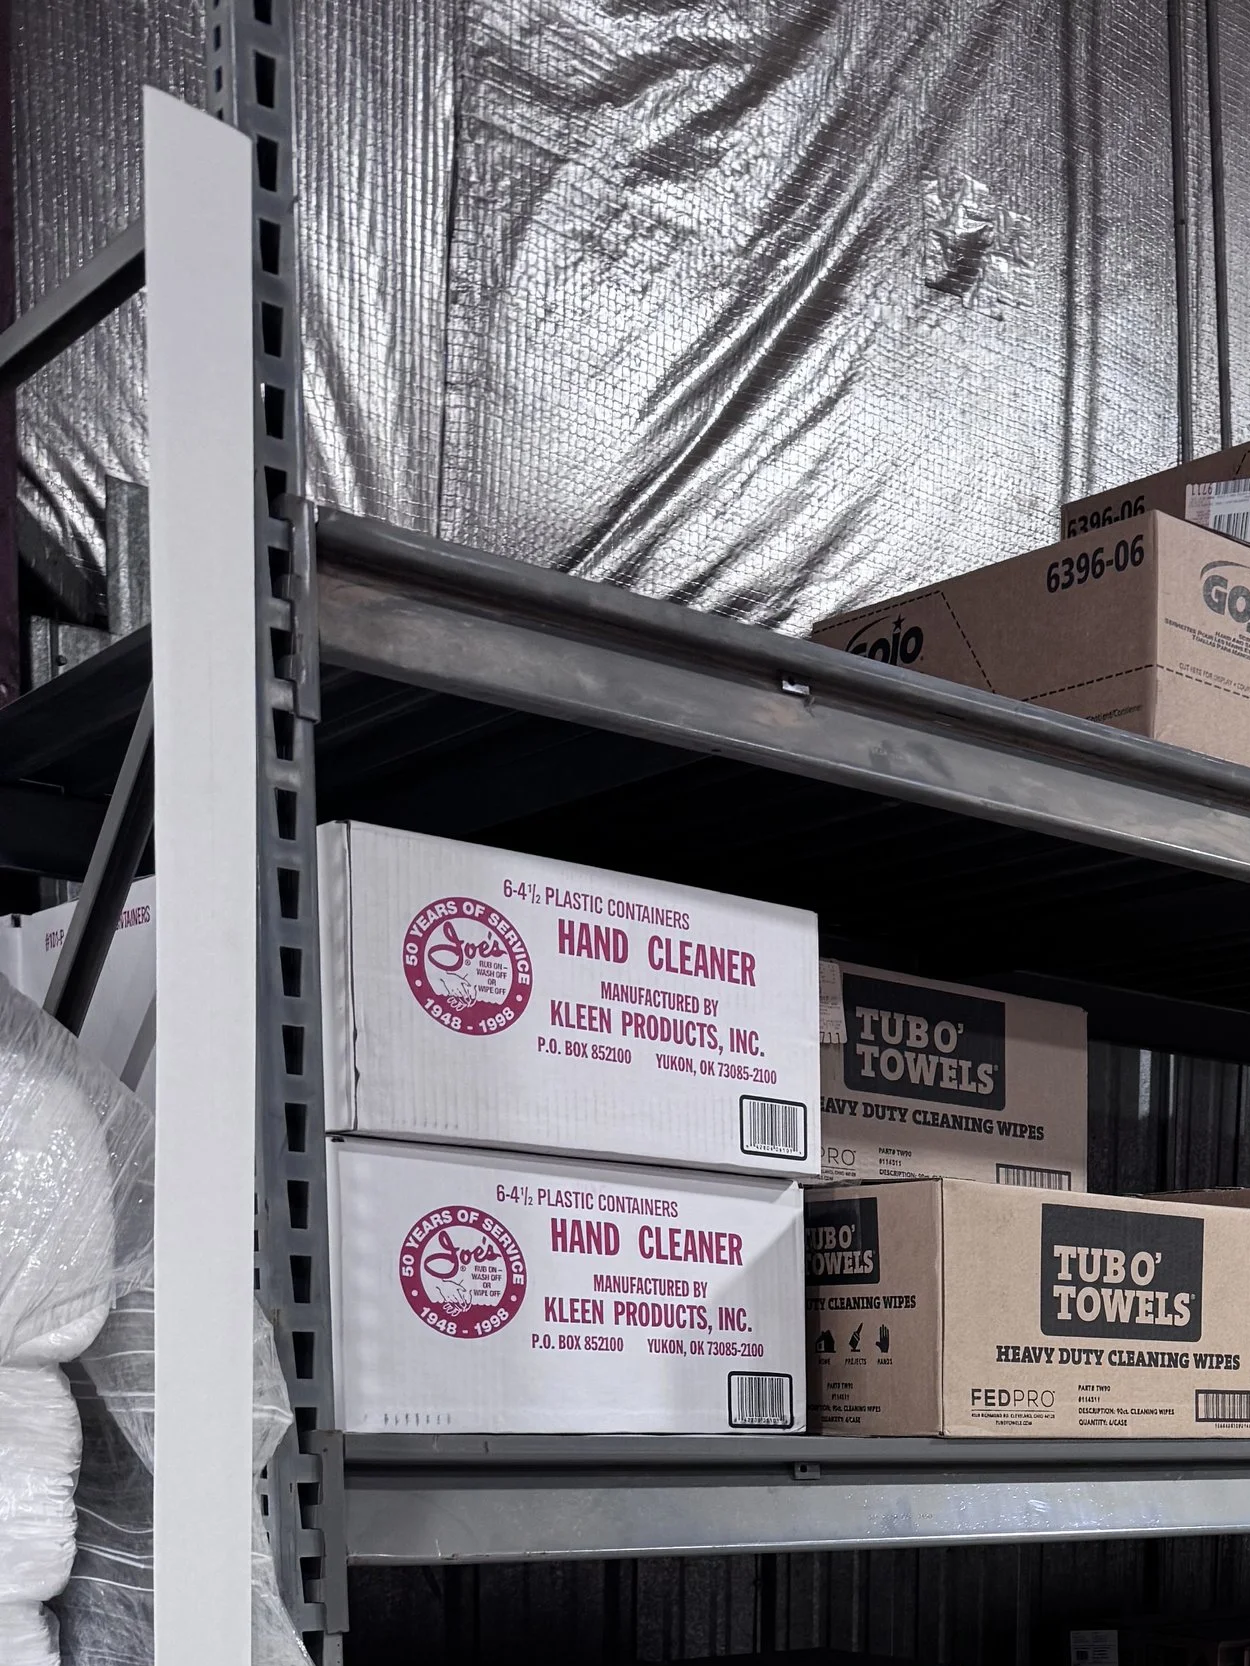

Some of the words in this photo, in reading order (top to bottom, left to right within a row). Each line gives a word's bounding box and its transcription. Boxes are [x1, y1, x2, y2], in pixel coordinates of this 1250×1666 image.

[1046, 534, 1144, 594] 6396-06
[410, 901, 457, 938] YEARS
[462, 901, 485, 918] OF
[545, 886, 603, 915] PLASTIC
[607, 898, 690, 930] CONTAINERS
[405, 942, 418, 967] 50
[487, 912, 530, 986] SERVICE
[557, 918, 629, 965] HAND
[647, 934, 757, 987] CLEANER
[424, 998, 462, 1031] 1948
[478, 1006, 515, 1033] 1998
[600, 980, 699, 1015] MANUFACTURED
[703, 998, 719, 1018] BY
[550, 999, 612, 1034] KLEEN
[621, 1010, 724, 1056] PRODUCTS,
[729, 1027, 766, 1057] INC.
[856, 1006, 930, 1049] TUB
[934, 1020, 964, 1053] O'
[537, 1036, 562, 1056] P.O.
[565, 1040, 588, 1060] BOX
[591, 1045, 632, 1065] 852100
[656, 1053, 697, 1077] YUKON,
[699, 1060, 715, 1077] OK
[717, 1062, 778, 1085] 73085-2100
[856, 1043, 994, 1096] TOWELS
[862, 1102, 909, 1124] DUTY
[912, 1109, 994, 1135] CLEANING
[997, 1120, 1045, 1141] WIPES
[551, 1217, 620, 1256] HAND
[638, 1225, 744, 1267] CLEANER
[1053, 1245, 1127, 1284] TUB
[1130, 1251, 1162, 1286] O'
[544, 1296, 605, 1326] KLEEN
[613, 1299, 713, 1335] PRODUCTS,
[718, 1306, 753, 1333] INC.
[1053, 1285, 1191, 1327] TOWELS
[996, 1345, 1058, 1365] HEAVY
[1059, 1348, 1105, 1367] DUTY
[1107, 1350, 1190, 1369] CLEANING
[1193, 1353, 1241, 1371] WIPES
